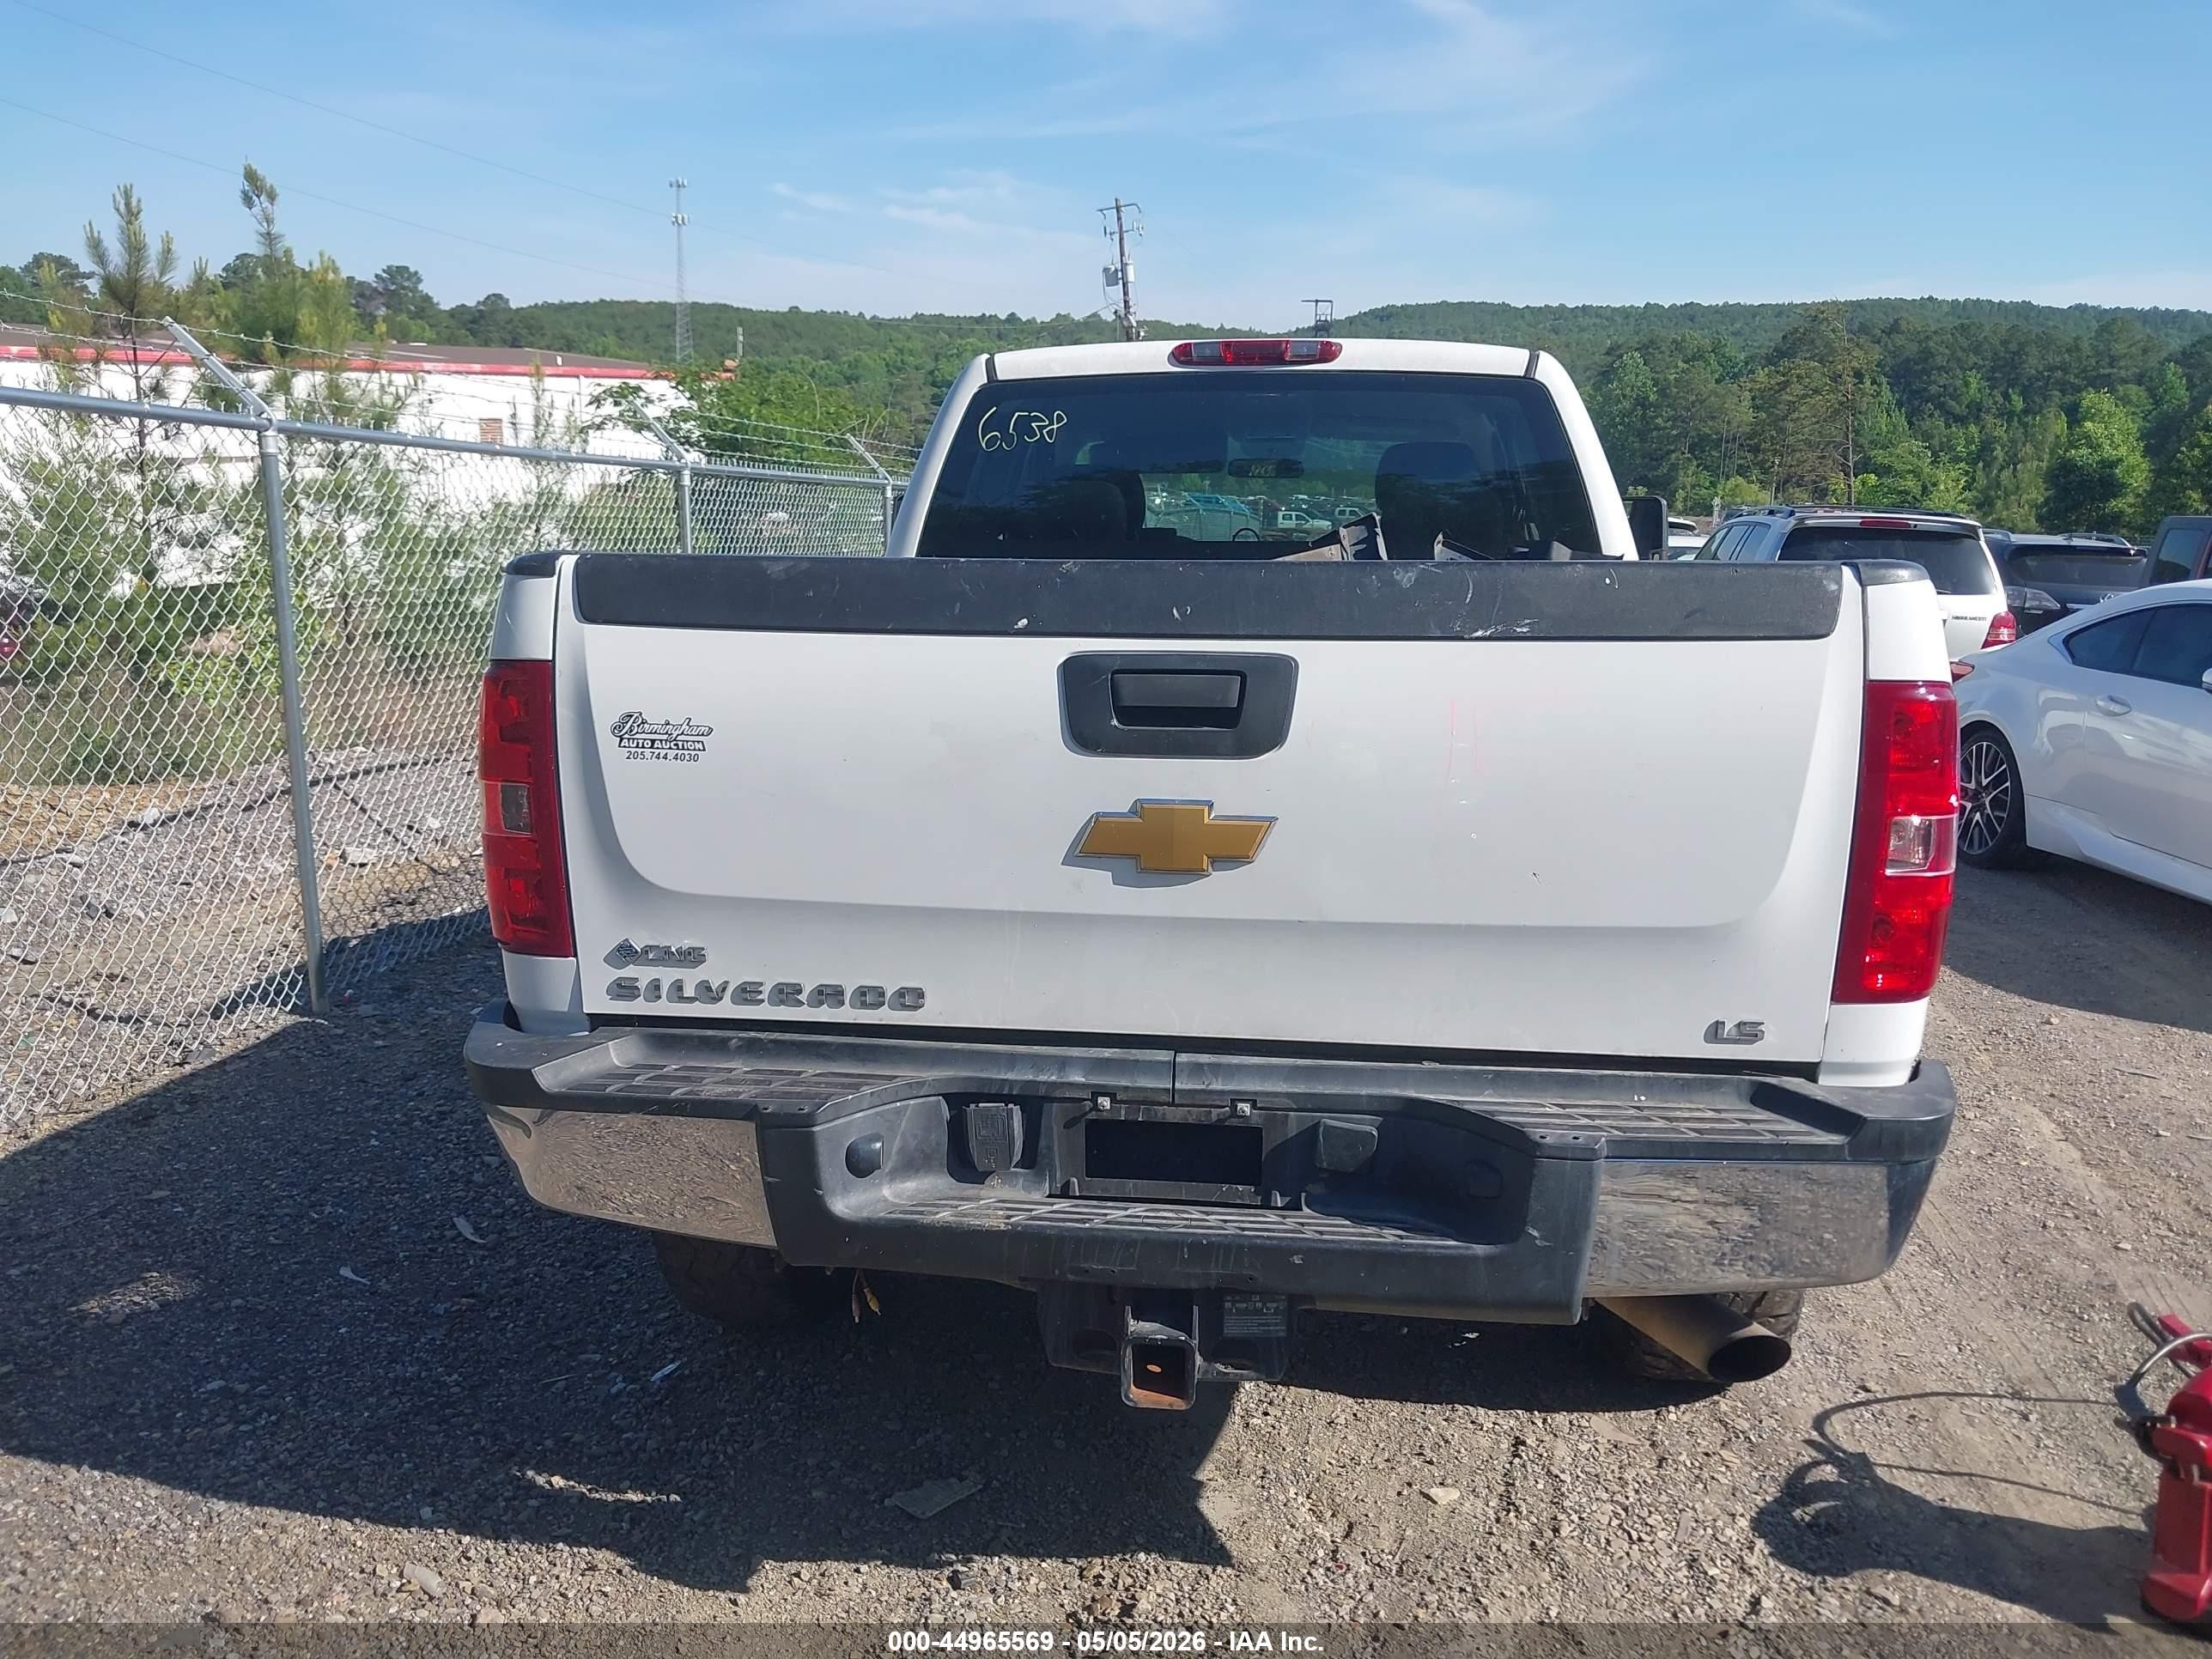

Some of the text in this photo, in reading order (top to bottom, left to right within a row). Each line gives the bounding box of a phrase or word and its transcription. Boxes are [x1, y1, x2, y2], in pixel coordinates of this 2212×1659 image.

[979, 406, 1067, 452] 6538
[611, 711, 714, 740] Birmingham
[620, 738, 703, 750] AUTO AUCTION
[625, 750, 700, 763] 205.744.4030
[606, 975, 927, 1012] SILVERADO
[1709, 1019, 1765, 1044] LS
